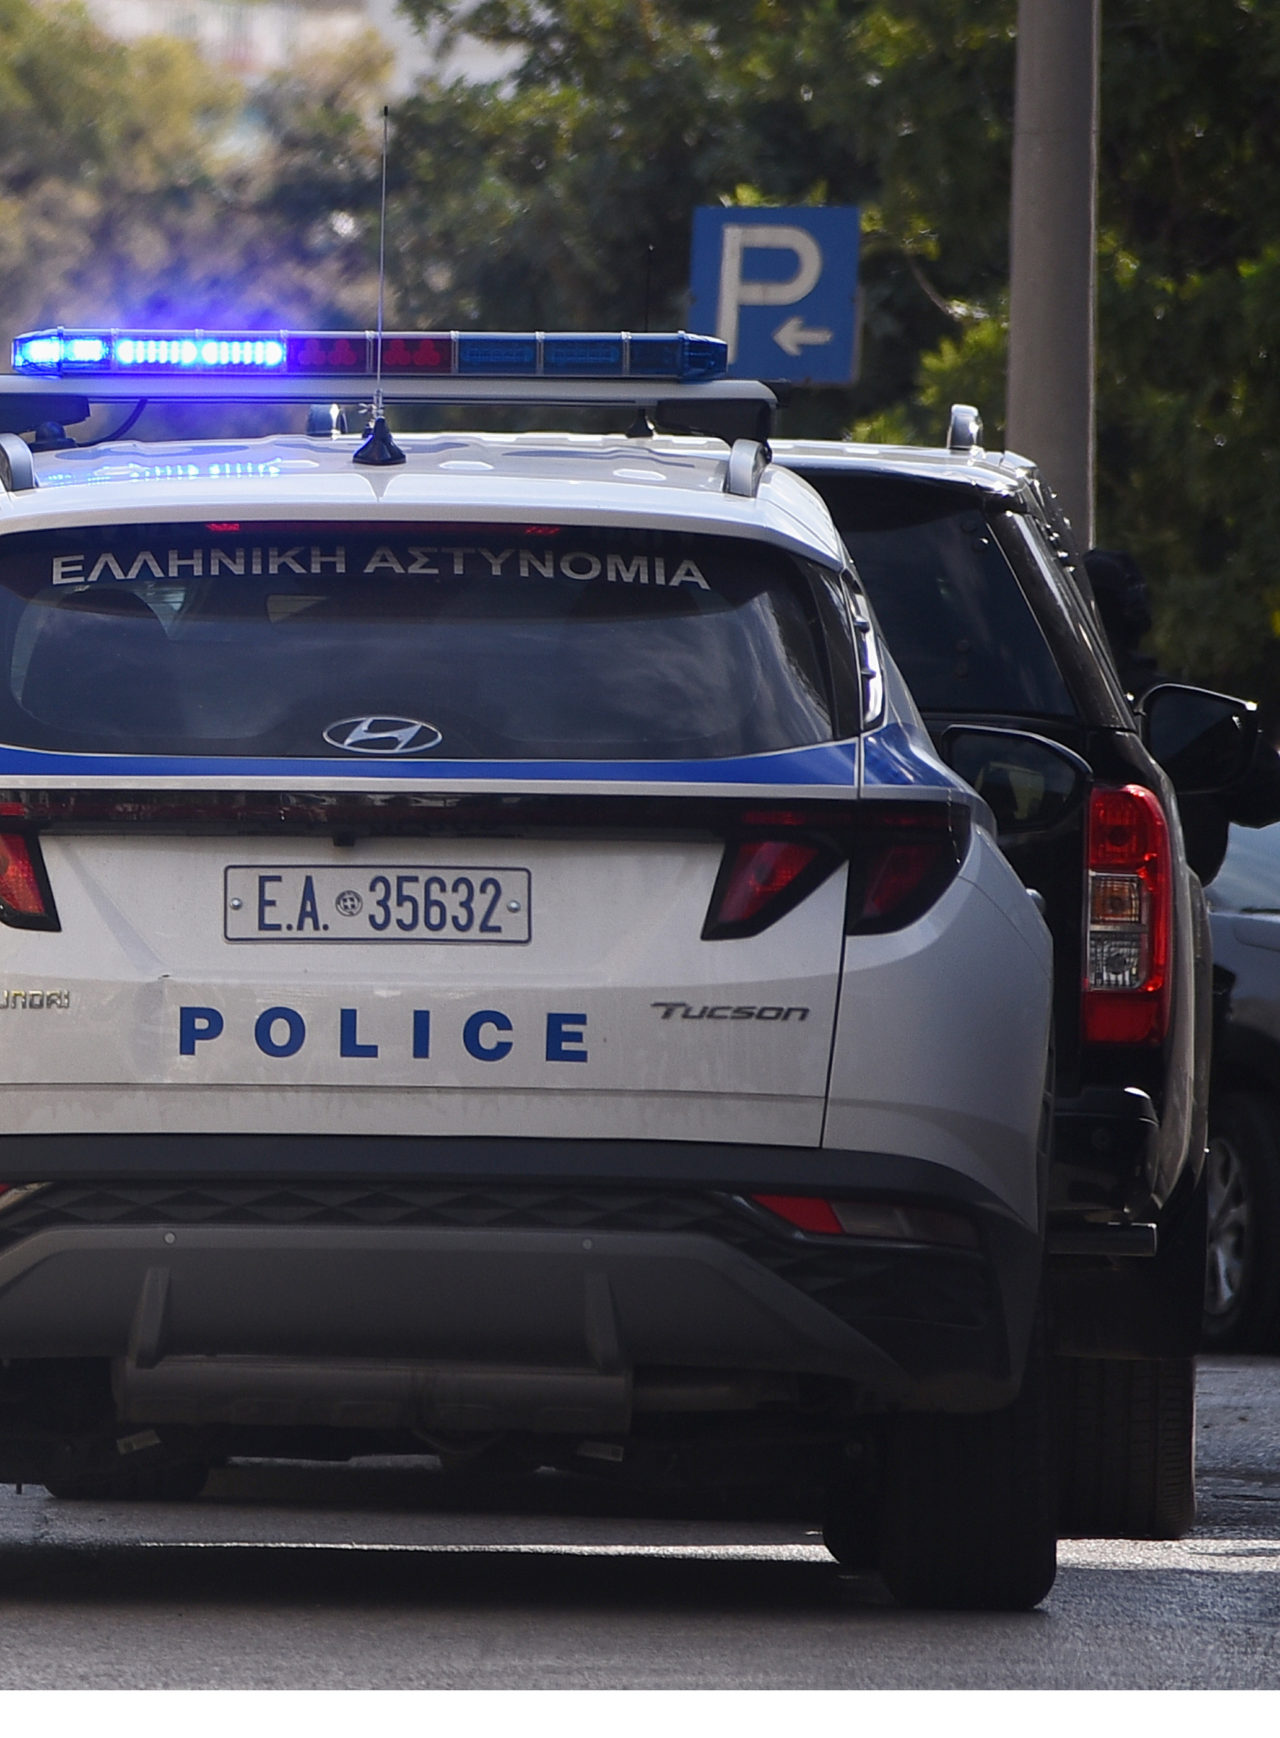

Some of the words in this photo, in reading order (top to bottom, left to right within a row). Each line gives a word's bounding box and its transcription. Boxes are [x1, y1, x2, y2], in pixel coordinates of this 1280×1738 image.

[716, 224, 822, 365] P
[52, 546, 346, 586] ΕΛΛΗΝΙΚΗ
[363, 545, 712, 590] ΑΣΤΥΝΟΜΙΑ
[368, 875, 503, 933] 35632
[178, 1006, 589, 1063] POLICE
